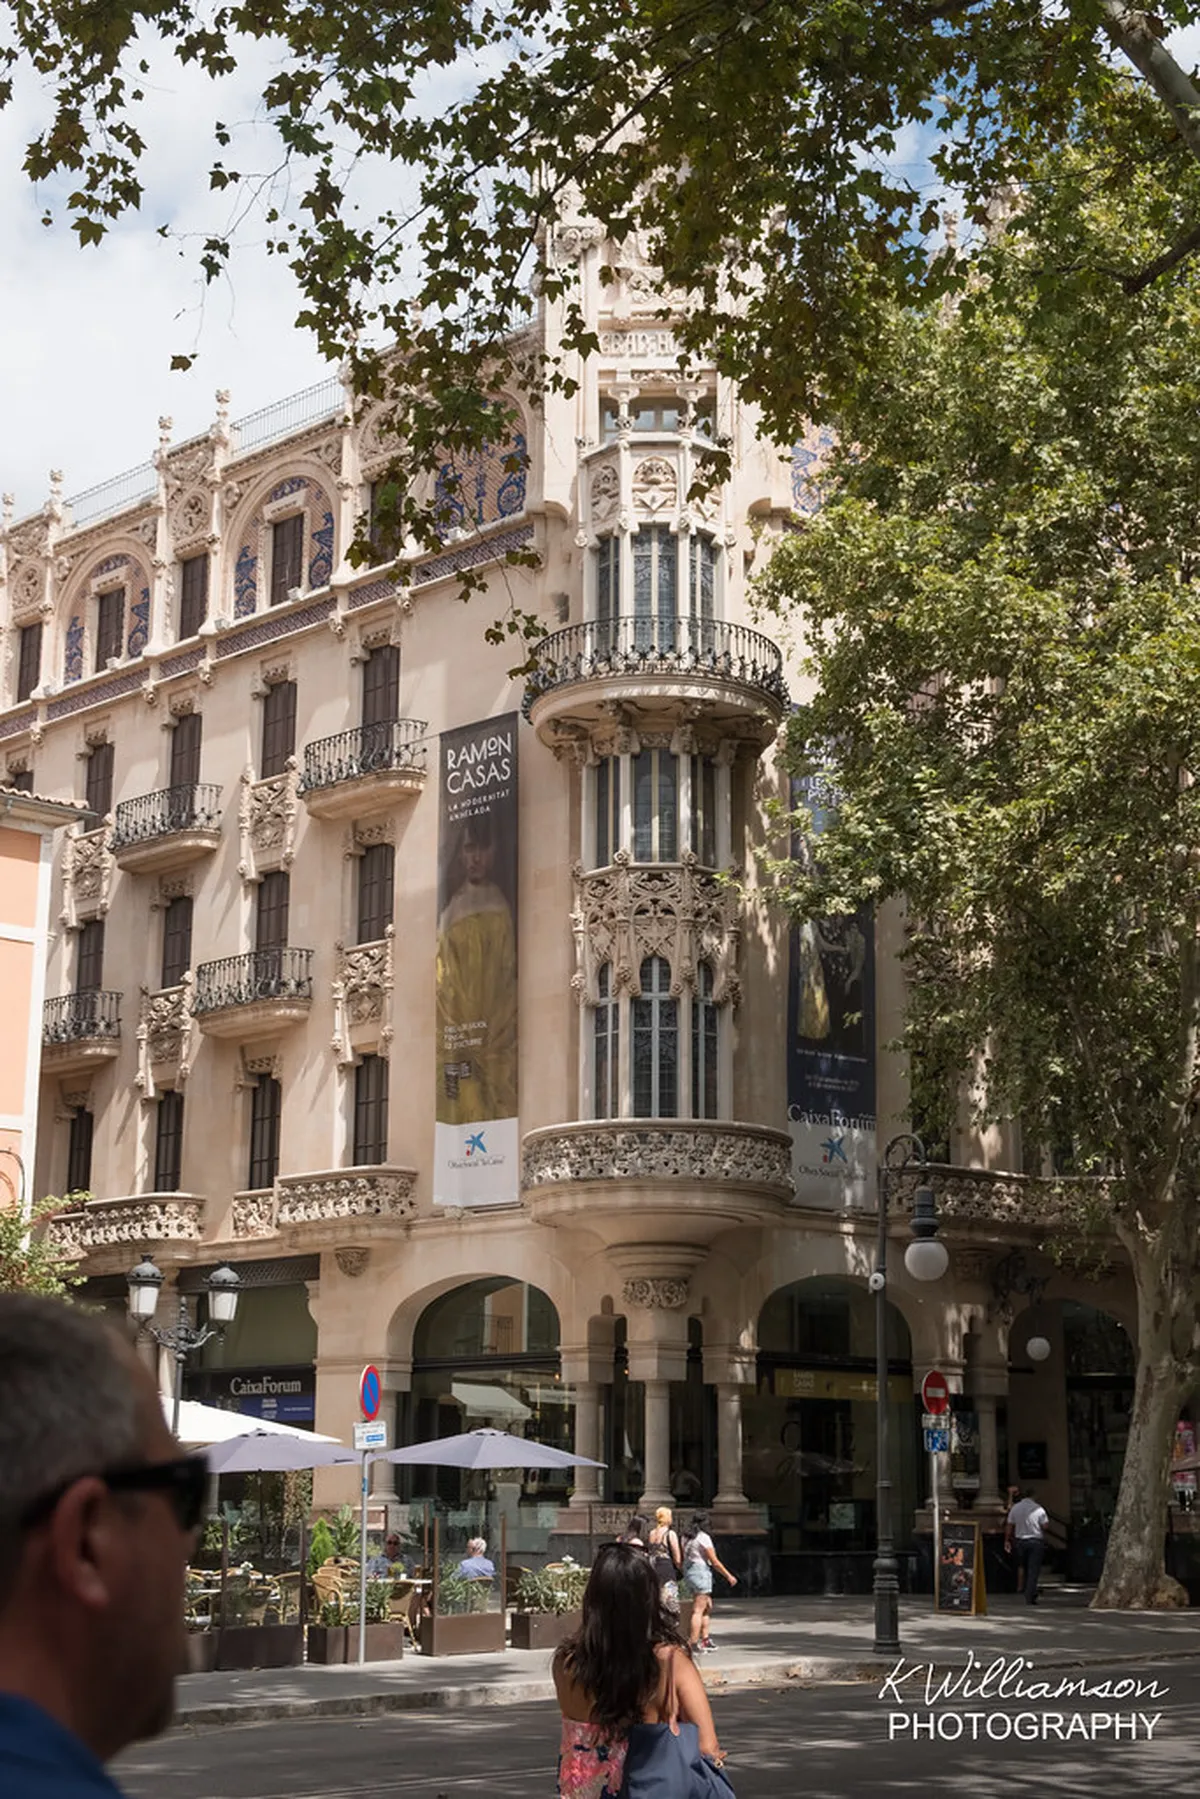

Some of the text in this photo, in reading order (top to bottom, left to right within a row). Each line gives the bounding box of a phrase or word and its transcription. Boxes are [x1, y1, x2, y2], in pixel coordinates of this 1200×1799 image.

[447, 732, 512, 771] RAMON
[447, 758, 512, 794] CASAS
[787, 1103, 877, 1132] CaixaForum
[229, 1376, 303, 1396] CaixaForum
